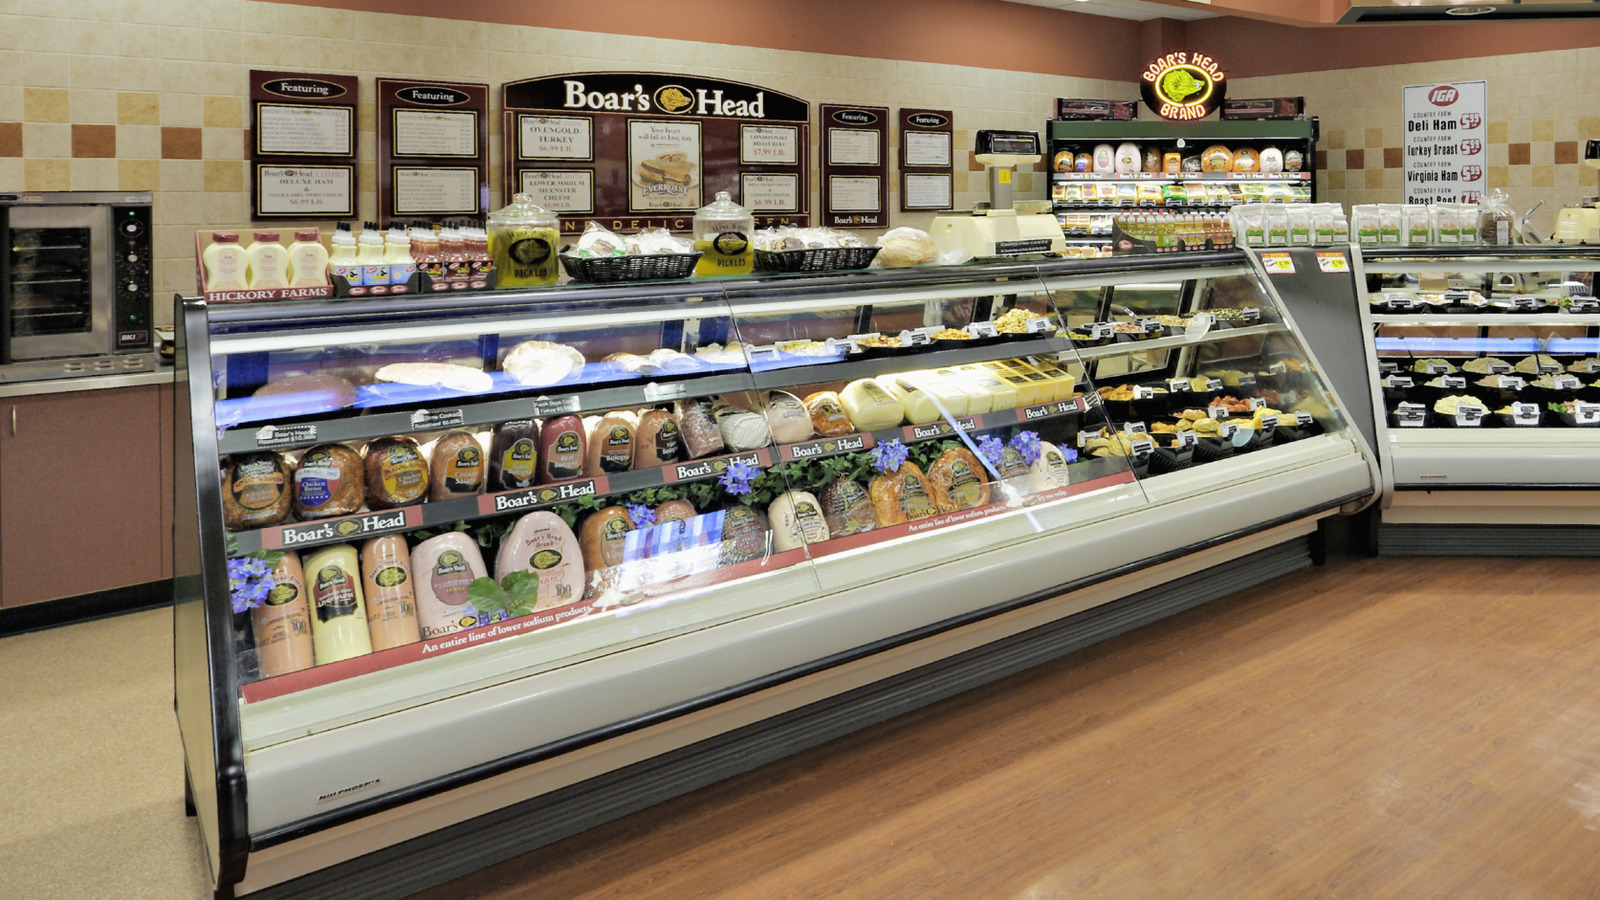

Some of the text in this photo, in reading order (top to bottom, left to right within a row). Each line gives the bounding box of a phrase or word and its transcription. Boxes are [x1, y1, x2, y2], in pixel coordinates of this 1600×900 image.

[1143, 52, 1224, 82] BOAR'S HEAD
[281, 82, 329, 96] Featuring
[1431, 89, 1457, 102] IGA
[412, 91, 454, 103] Featuring
[564, 80, 764, 118] Boar's Head
[842, 112, 868, 122] Featuring
[1160, 103, 1206, 120] BRAND
[916, 116, 940, 125] Featuring
[1408, 119, 1457, 132] Deli Ham
[1408, 144, 1458, 157] Turkey Breast
[1408, 170, 1458, 183] Virginia Ham
[643, 183, 688, 197] EVERROAST
[834, 215, 878, 224] Boar's Head
[718, 258, 746, 267] PICKLES
[209, 287, 328, 301] HICKORY FARMS
[1025, 400, 1078, 419] Boar's Head
[914, 418, 975, 438] Boar's Head
[792, 436, 864, 458] Boar's Head
[554, 460, 578, 469] Bologna
[677, 454, 759, 479] Boar's Head
[496, 481, 595, 510] Boar's Head
[905, 504, 957, 520] Boar's Head
[283, 512, 405, 545] Boar's Head
[908, 524, 918, 532] An
[919, 520, 934, 530] entire
[934, 519, 945, 527] line
[951, 514, 965, 523] lower
[965, 510, 984, 520] sodium
[422, 620, 458, 637] Boar's
[422, 643, 438, 653] An
[440, 637, 467, 649] entire
[468, 632, 486, 641] line
[487, 626, 497, 637] of
[498, 623, 521, 635] lower
[523, 615, 554, 630] sodium
